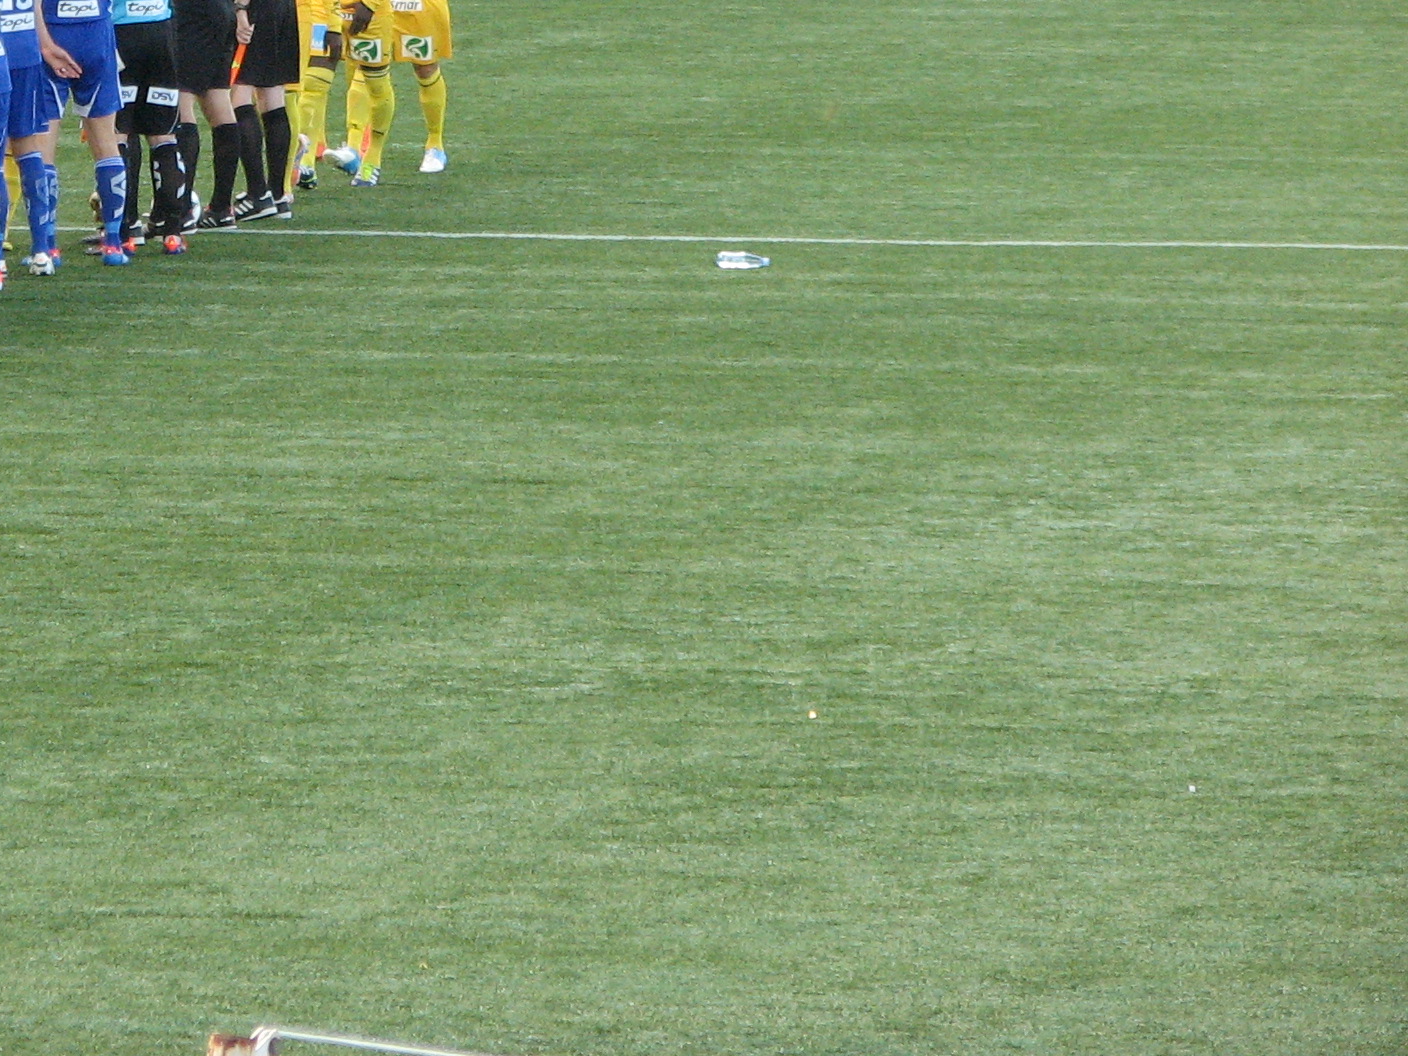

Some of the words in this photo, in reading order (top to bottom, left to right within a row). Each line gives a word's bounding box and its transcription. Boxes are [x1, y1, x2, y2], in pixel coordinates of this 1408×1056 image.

[59, 0, 97, 17] topi
[127, 0, 163, 16] topi
[151, 90, 176, 103] DSV
